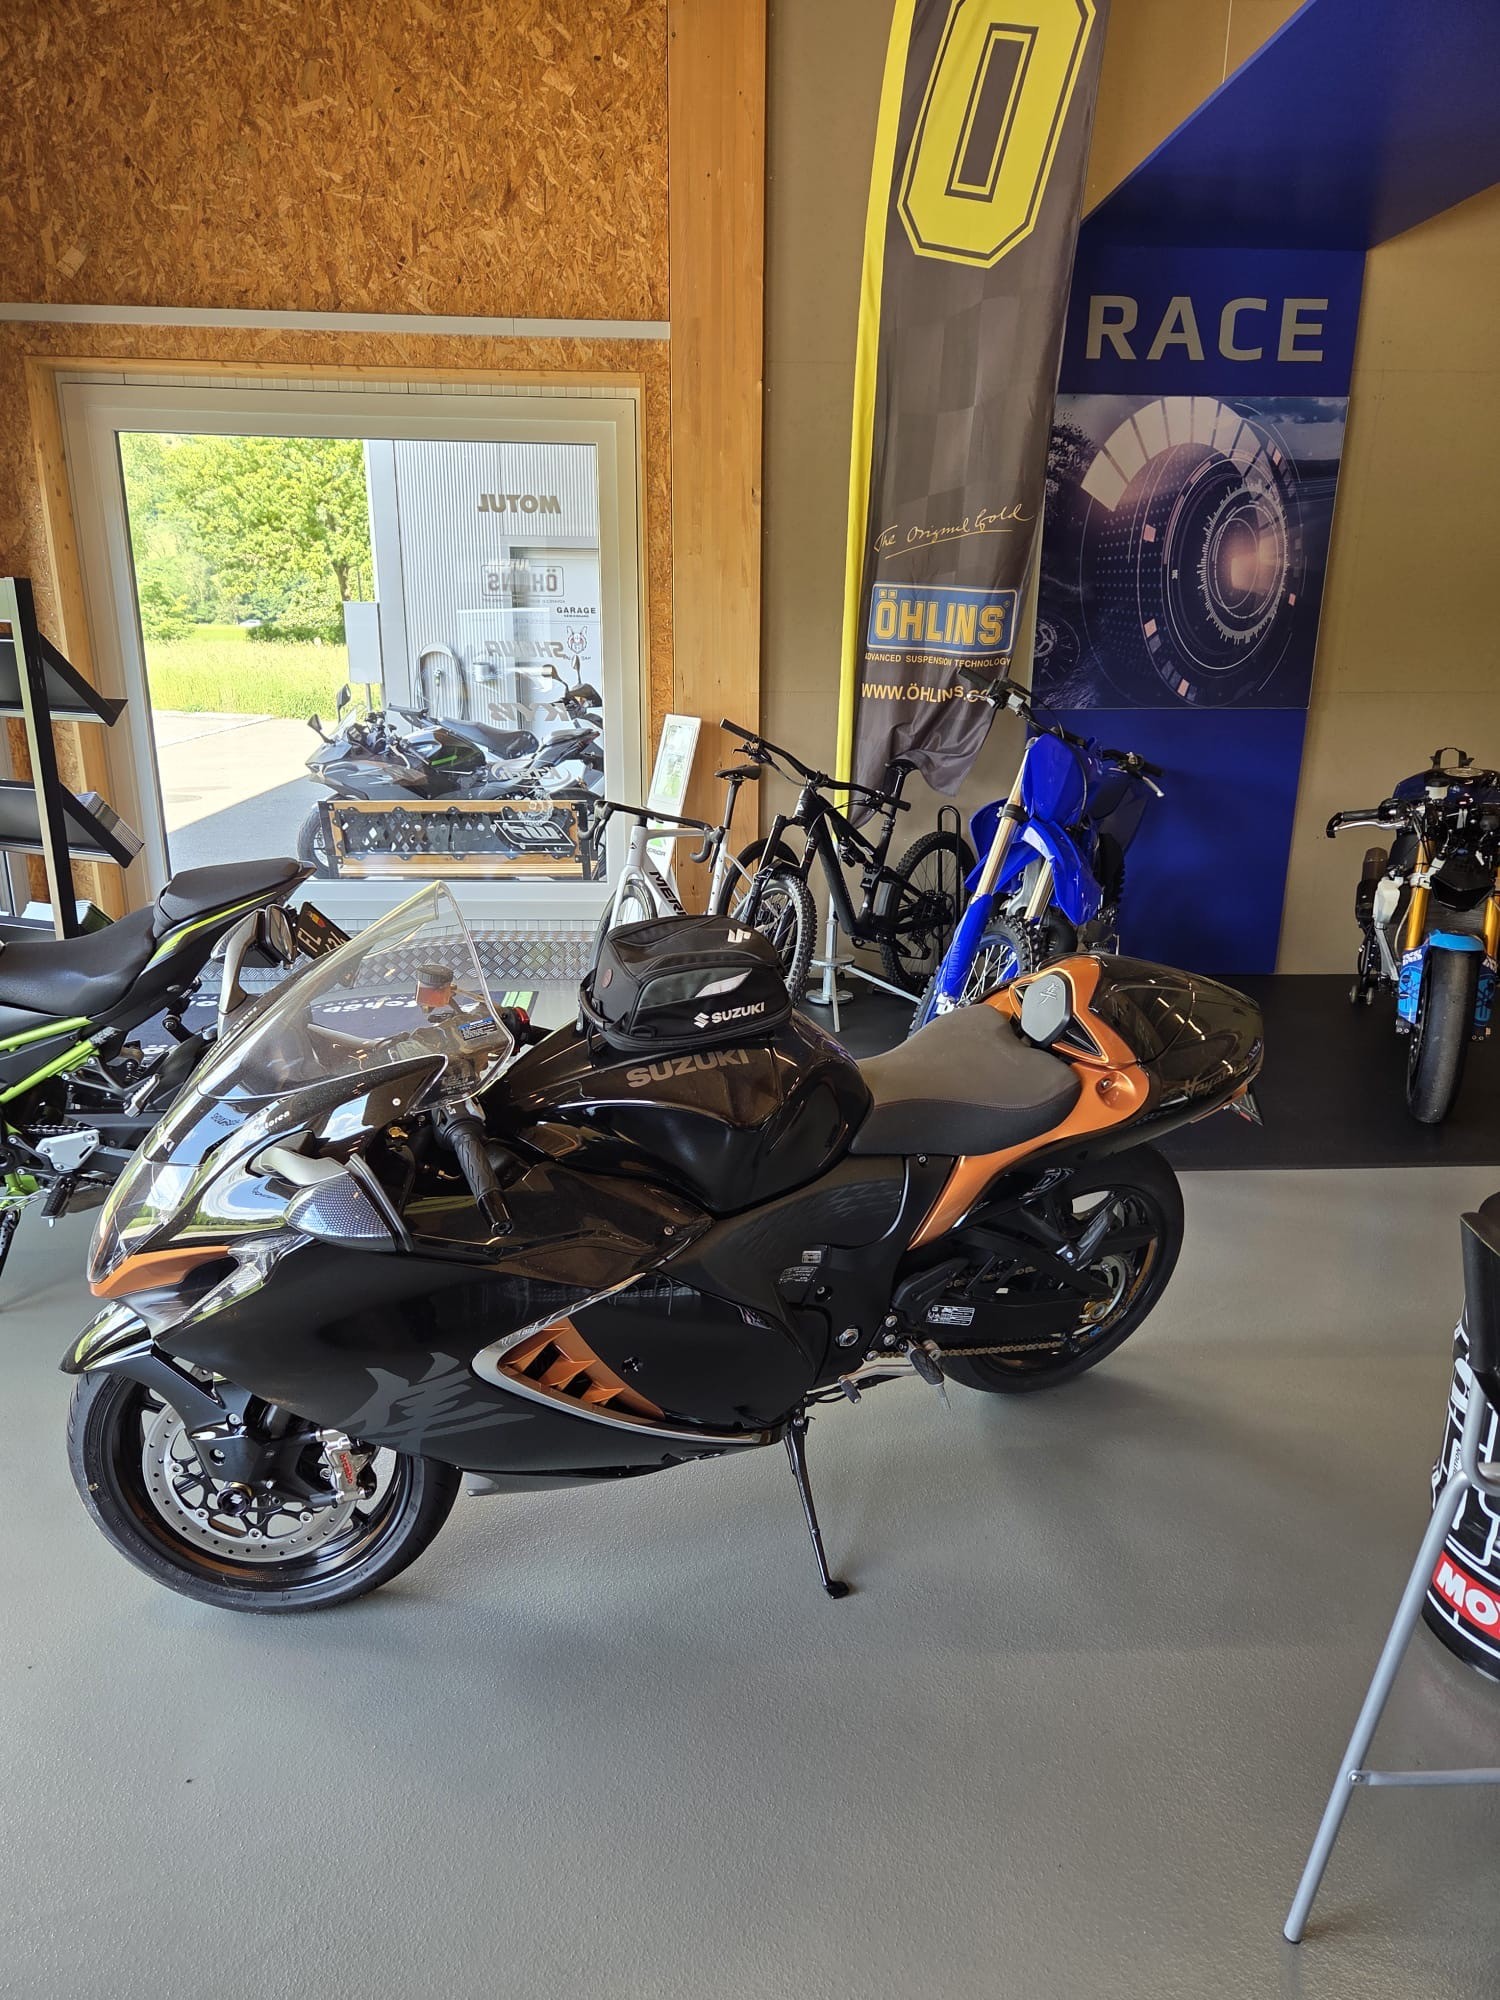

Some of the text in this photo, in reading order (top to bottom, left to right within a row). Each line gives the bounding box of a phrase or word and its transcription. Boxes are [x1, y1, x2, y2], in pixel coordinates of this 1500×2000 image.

[1085, 295, 1329, 362] RACE
[874, 525, 898, 552] The
[975, 504, 1034, 532] Gold
[556, 606, 596, 614] GARAGE
[874, 589, 1005, 646] ÖHLINS
[955, 659, 1011, 667] TECHNOLOGY
[711, 1002, 765, 1024] SUZUKI
[626, 1049, 749, 1088] SUZUKI
[1437, 1561, 1500, 1626] MO
